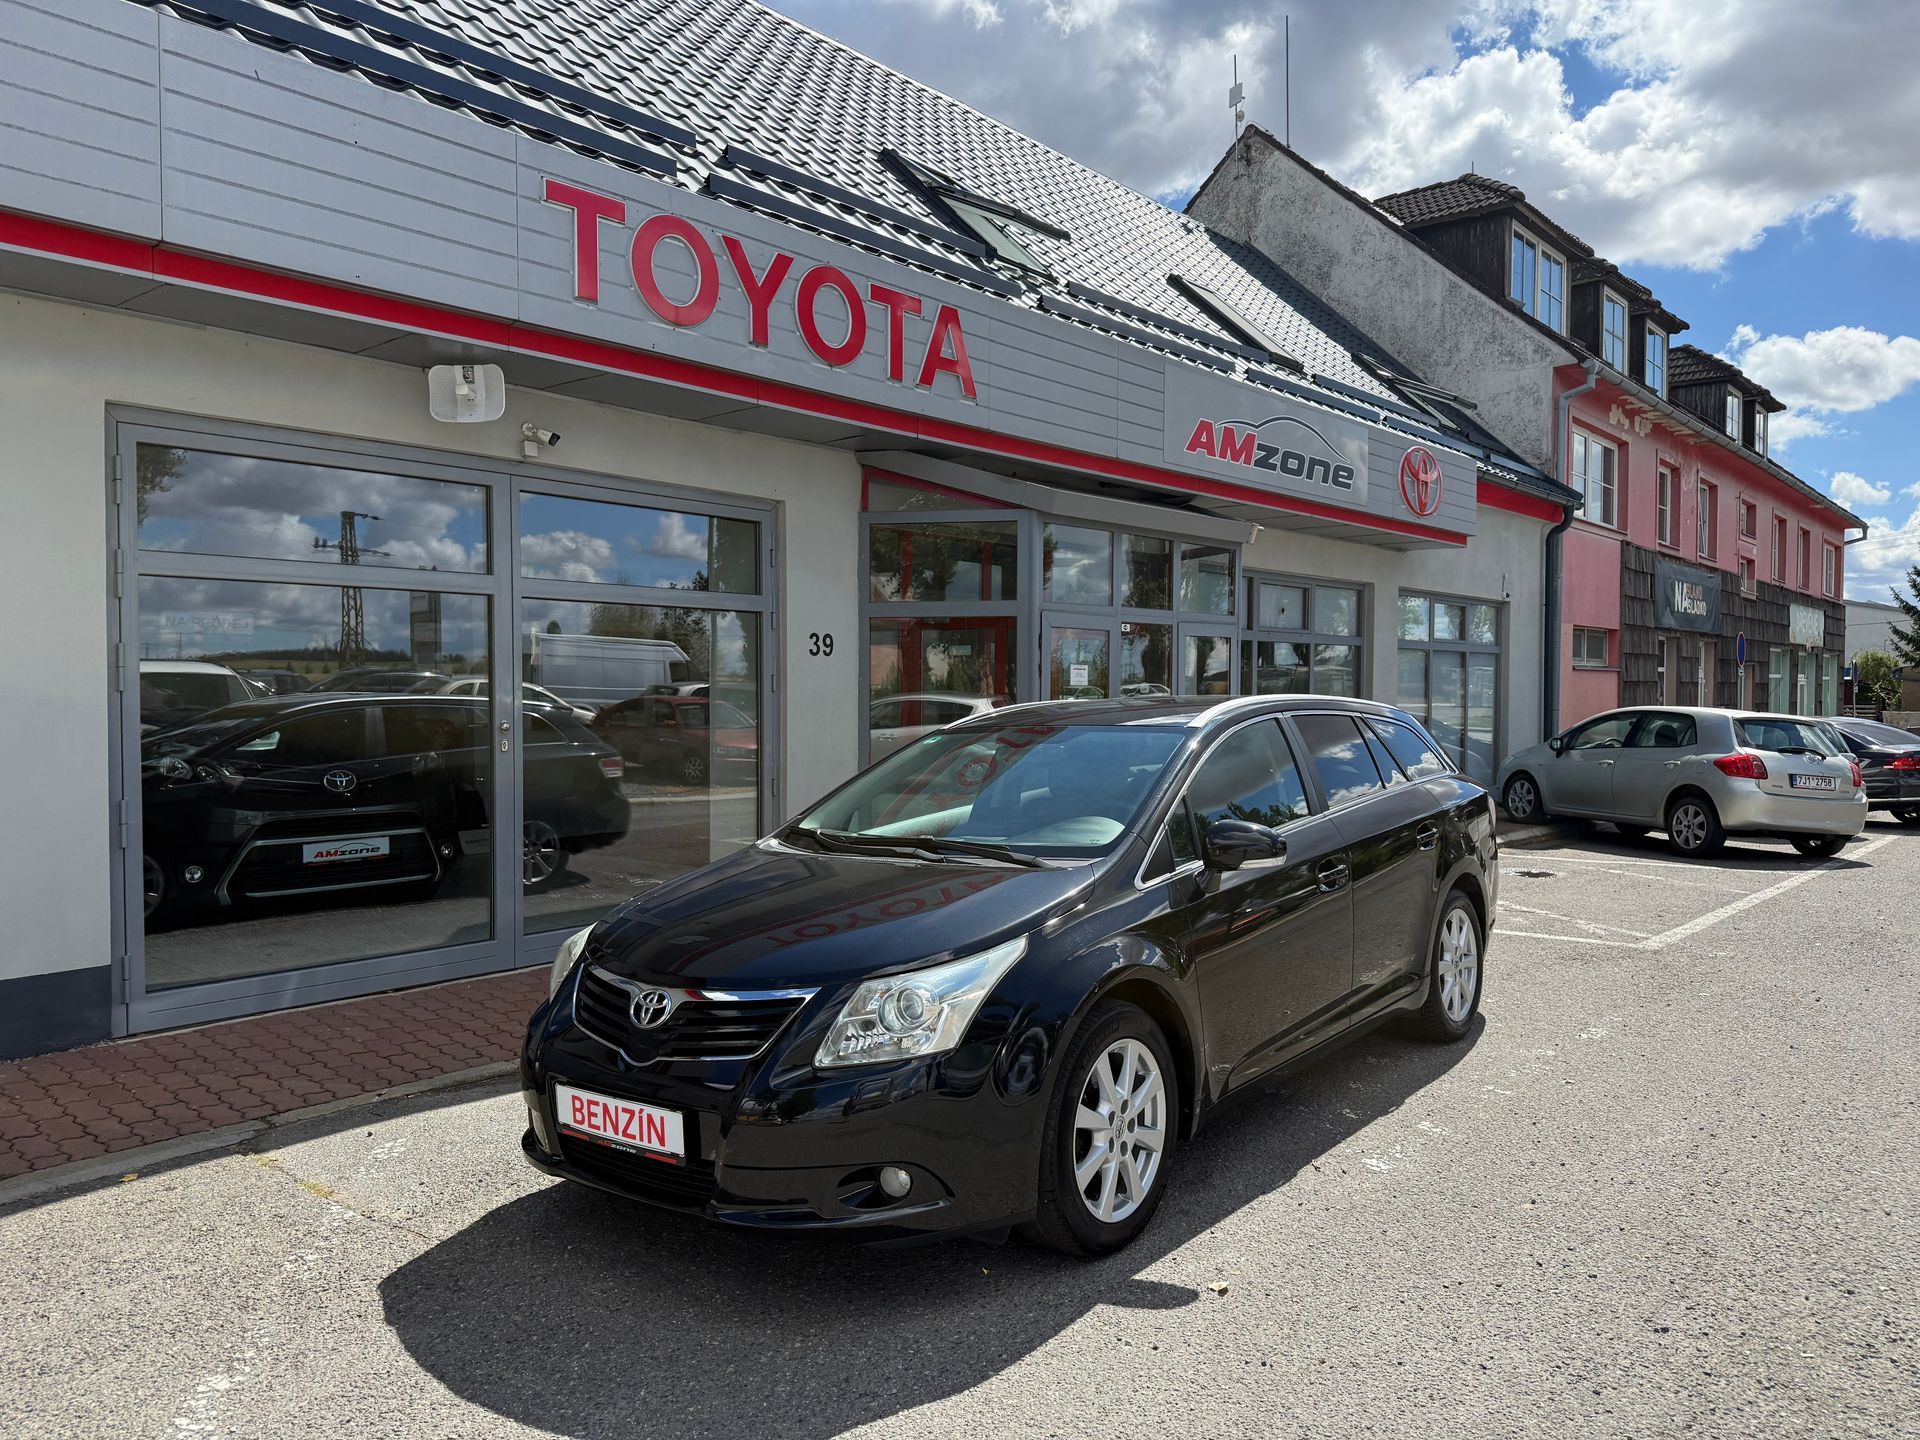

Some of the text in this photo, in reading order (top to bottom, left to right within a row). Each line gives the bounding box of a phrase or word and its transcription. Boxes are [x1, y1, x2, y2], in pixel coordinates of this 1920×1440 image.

[543, 178, 977, 399] TOYOTA
[1184, 417, 1355, 491] AMzone
[1674, 580, 1688, 613] NA
[808, 632, 834, 657] 39
[313, 846, 381, 859] AMzone
[570, 1094, 667, 1148] BENZÍN
